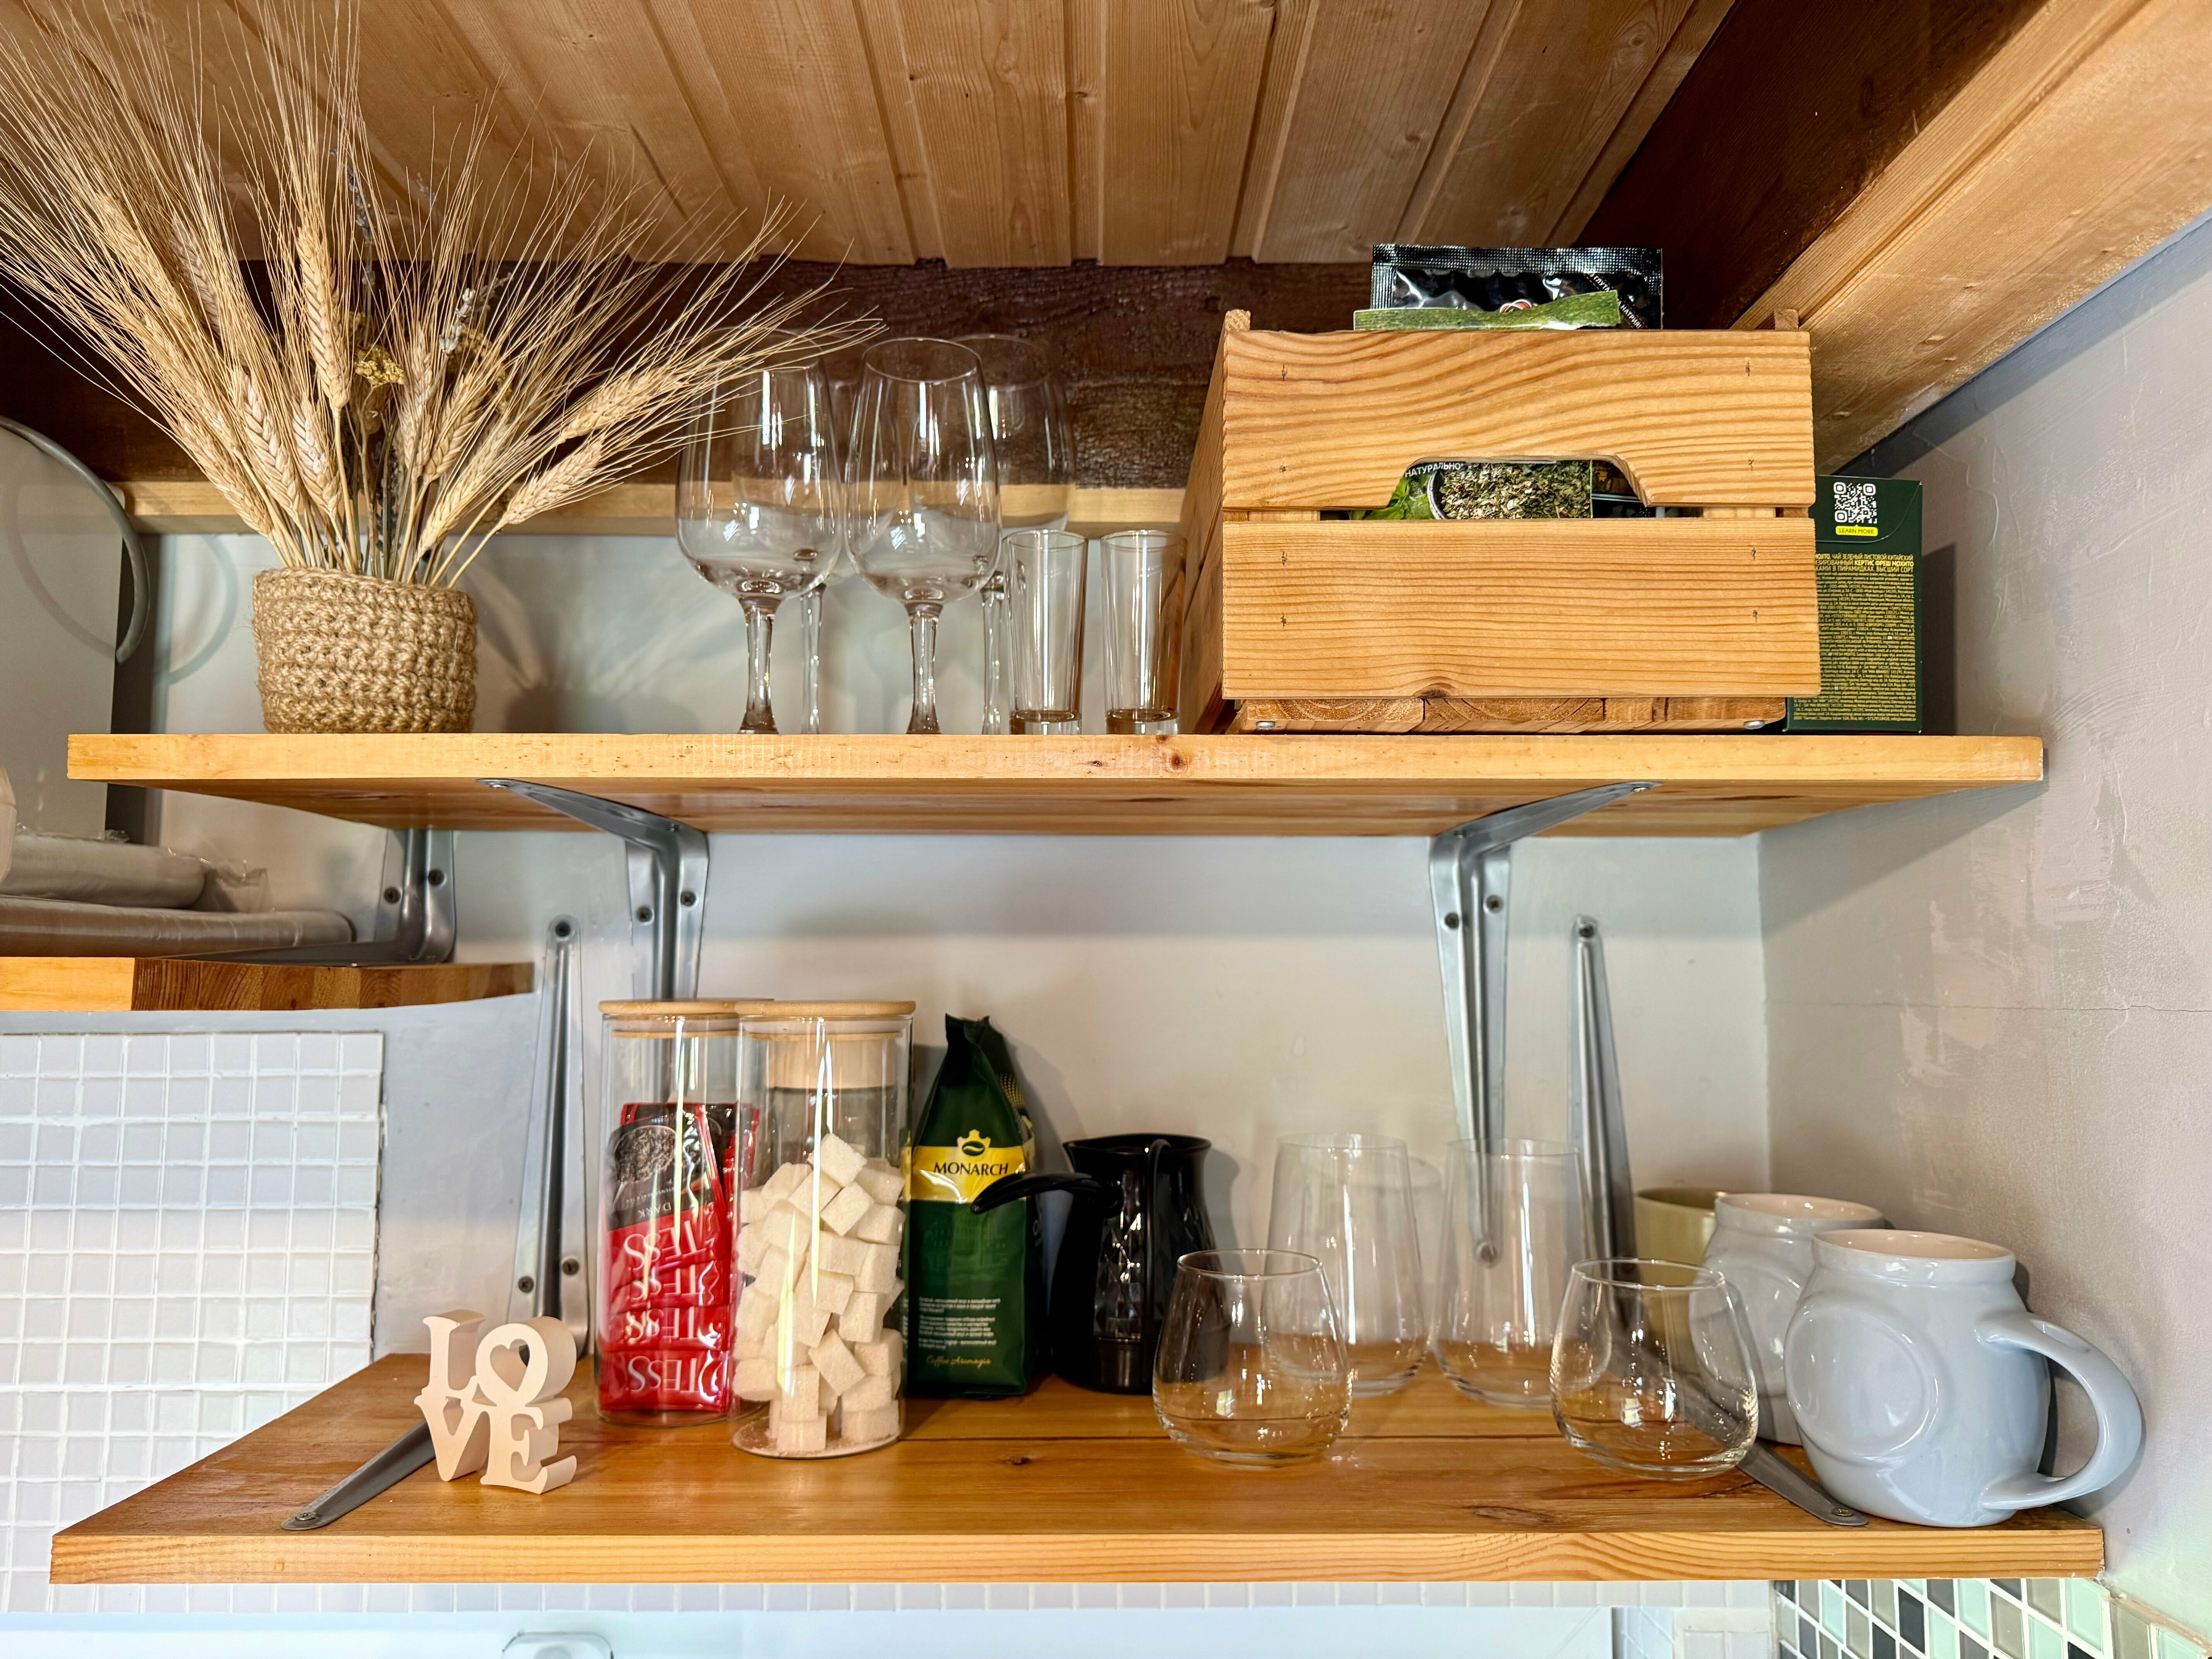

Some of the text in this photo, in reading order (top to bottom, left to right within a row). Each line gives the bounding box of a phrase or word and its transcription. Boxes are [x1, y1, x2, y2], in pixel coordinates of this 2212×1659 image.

[1593, 275, 1642, 329] ГЛУТАА НАТРИЯ!
[933, 1162, 1008, 1176] MONARCH
[638, 1201, 672, 1219] DARK
[624, 1220, 707, 1271] TESS
[630, 1264, 706, 1301] TESS
[626, 1306, 701, 1345] TESS
[627, 1355, 700, 1393] TESS
